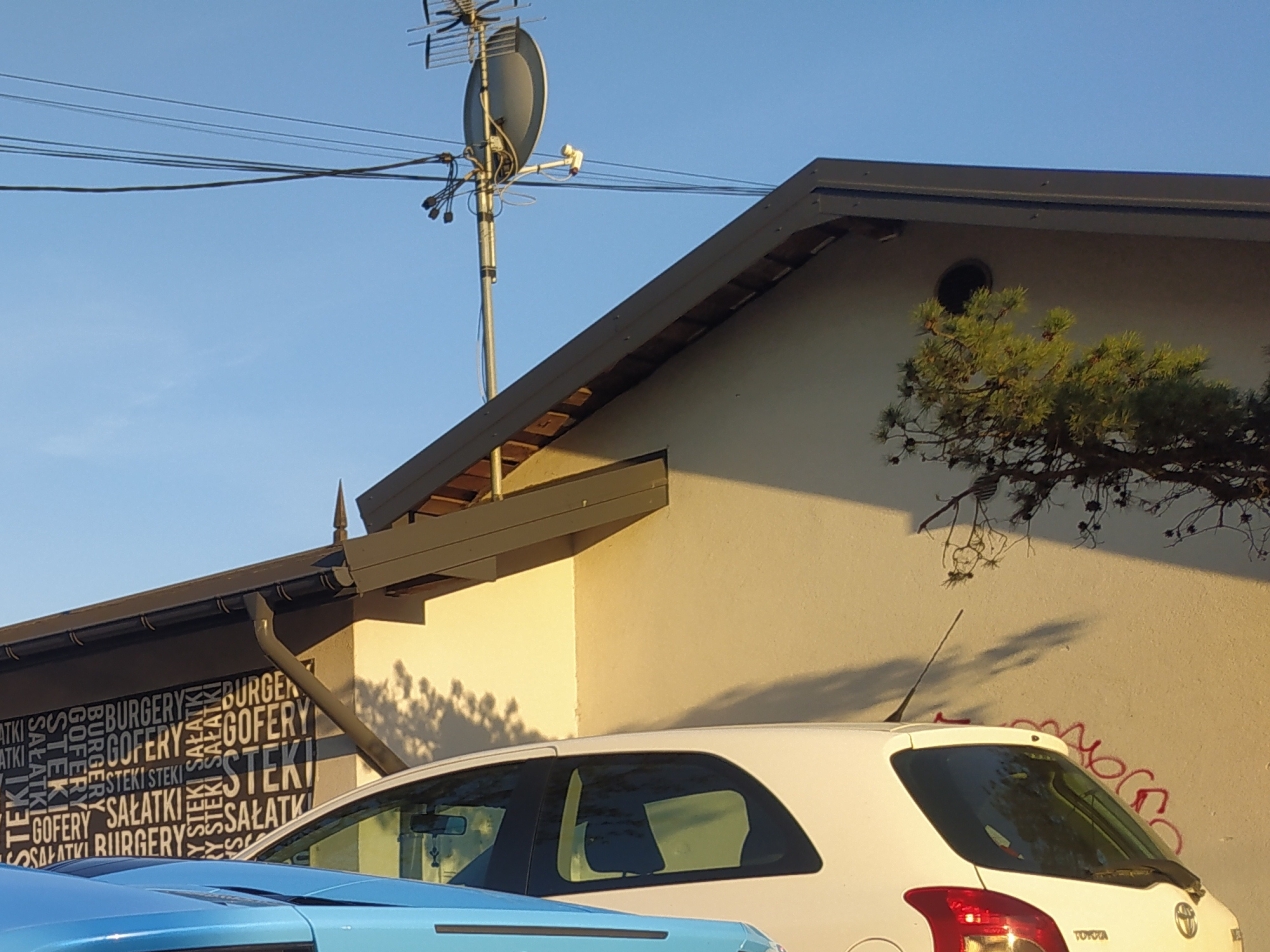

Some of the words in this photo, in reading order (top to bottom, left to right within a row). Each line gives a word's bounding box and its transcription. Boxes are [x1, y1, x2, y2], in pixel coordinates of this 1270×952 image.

[105, 689, 186, 733] BURGERY
[222, 664, 311, 710] BURGER
[106, 721, 184, 767] GOFERY
[186, 685, 204, 772] SAŁATKI
[204, 682, 222, 769] SAŁATKI
[222, 698, 311, 747] GOFERY
[28, 715, 47, 815] SAŁATKI
[47, 713, 69, 812] STEKI
[69, 707, 88, 811] GOFERY
[88, 705, 106, 812] BURGERY
[106, 766, 146, 794] STEKI
[148, 764, 184, 789] STEKI
[222, 737, 313, 798] STEKI
[5, 775, 30, 867] STEKI
[32, 811, 91, 845] GOFERY
[106, 787, 182, 829] SAŁATKI
[186, 778, 205, 837] STEKI
[204, 775, 223, 835] STEKI
[94, 824, 187, 857] BURGERY
[1073, 930, 1108, 940] TOYOTA
